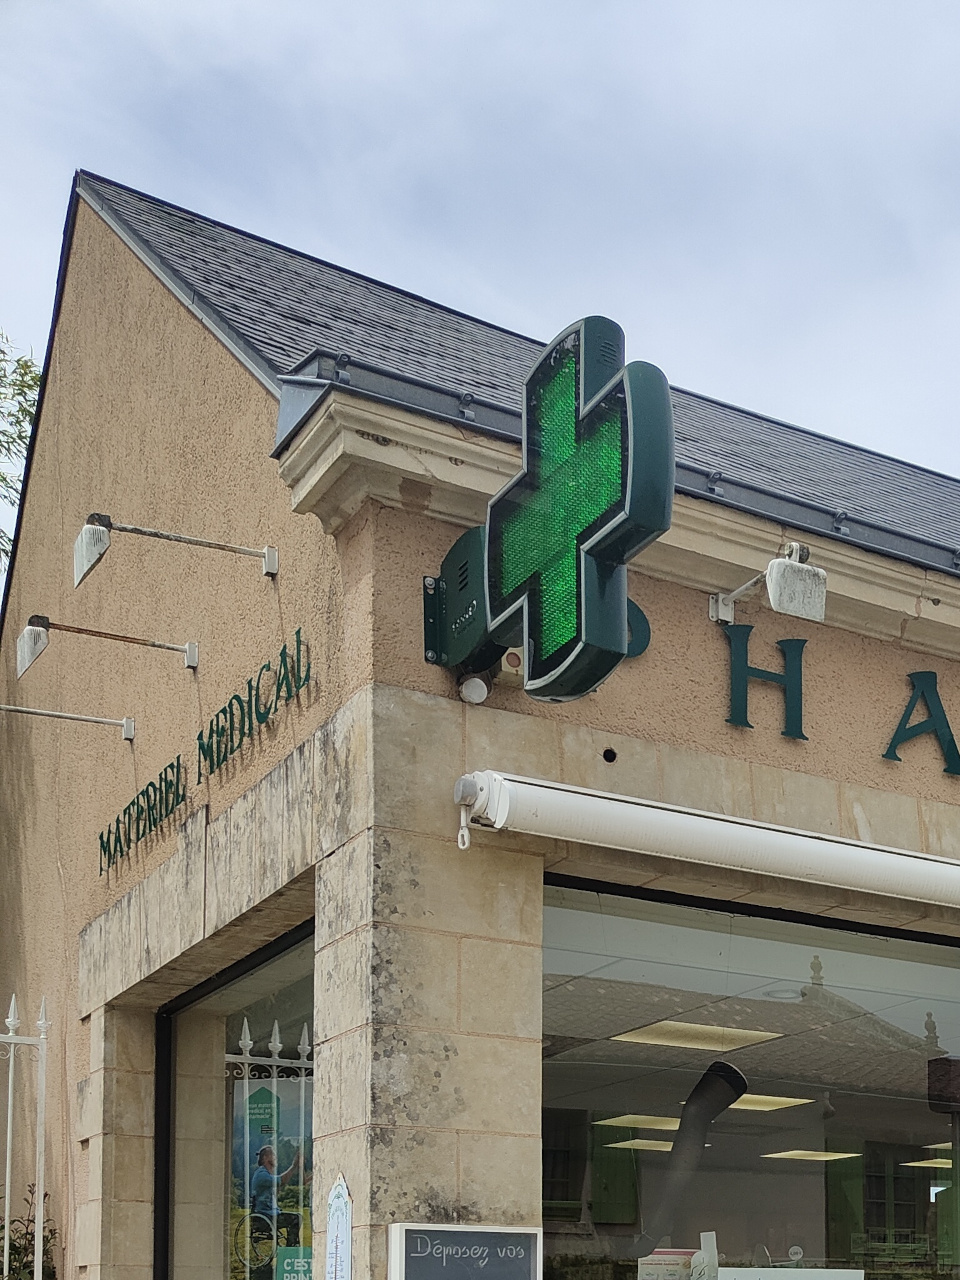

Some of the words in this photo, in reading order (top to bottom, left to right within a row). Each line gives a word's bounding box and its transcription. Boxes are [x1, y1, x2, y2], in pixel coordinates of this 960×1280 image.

[98, 754, 187, 877] MATERIEL
[197, 627, 311, 786] MEDICAL
[410, 1234, 489, 1267] Déposez
[497, 1245, 525, 1258] vos
